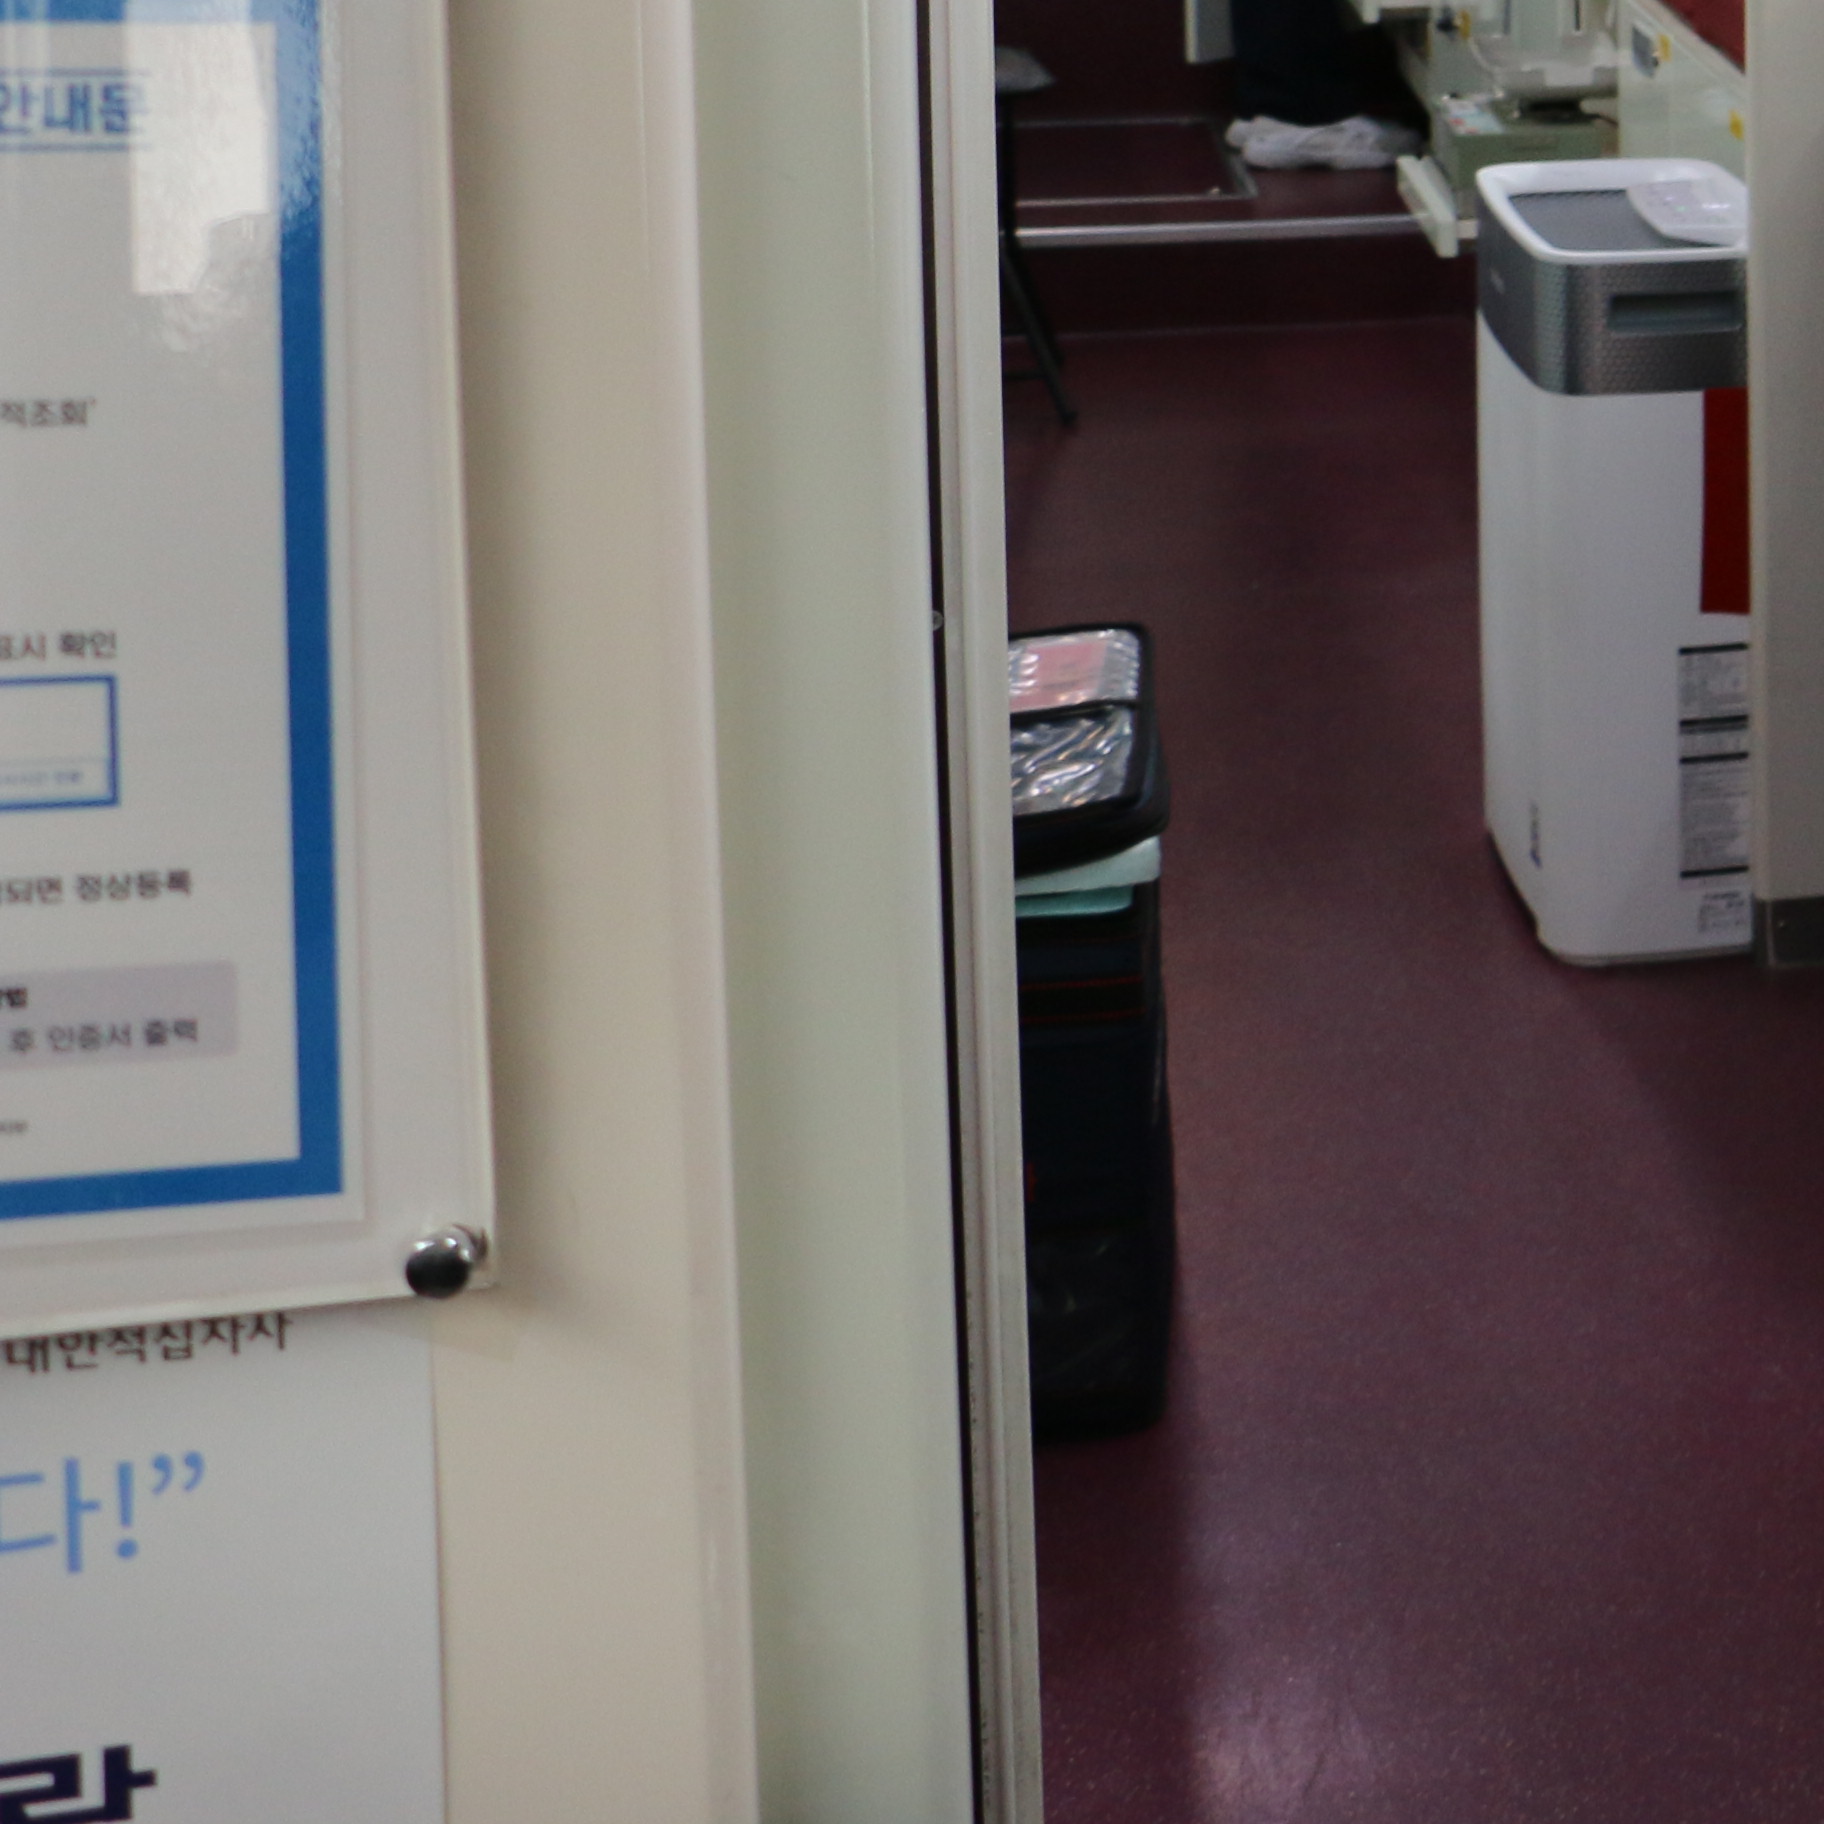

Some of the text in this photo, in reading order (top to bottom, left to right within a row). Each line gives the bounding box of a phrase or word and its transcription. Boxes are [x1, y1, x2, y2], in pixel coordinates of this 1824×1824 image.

[76, 869, 192, 900] 정상등록
[49, 1022, 132, 1053] 인증서
[144, 1018, 198, 1047] 출력
